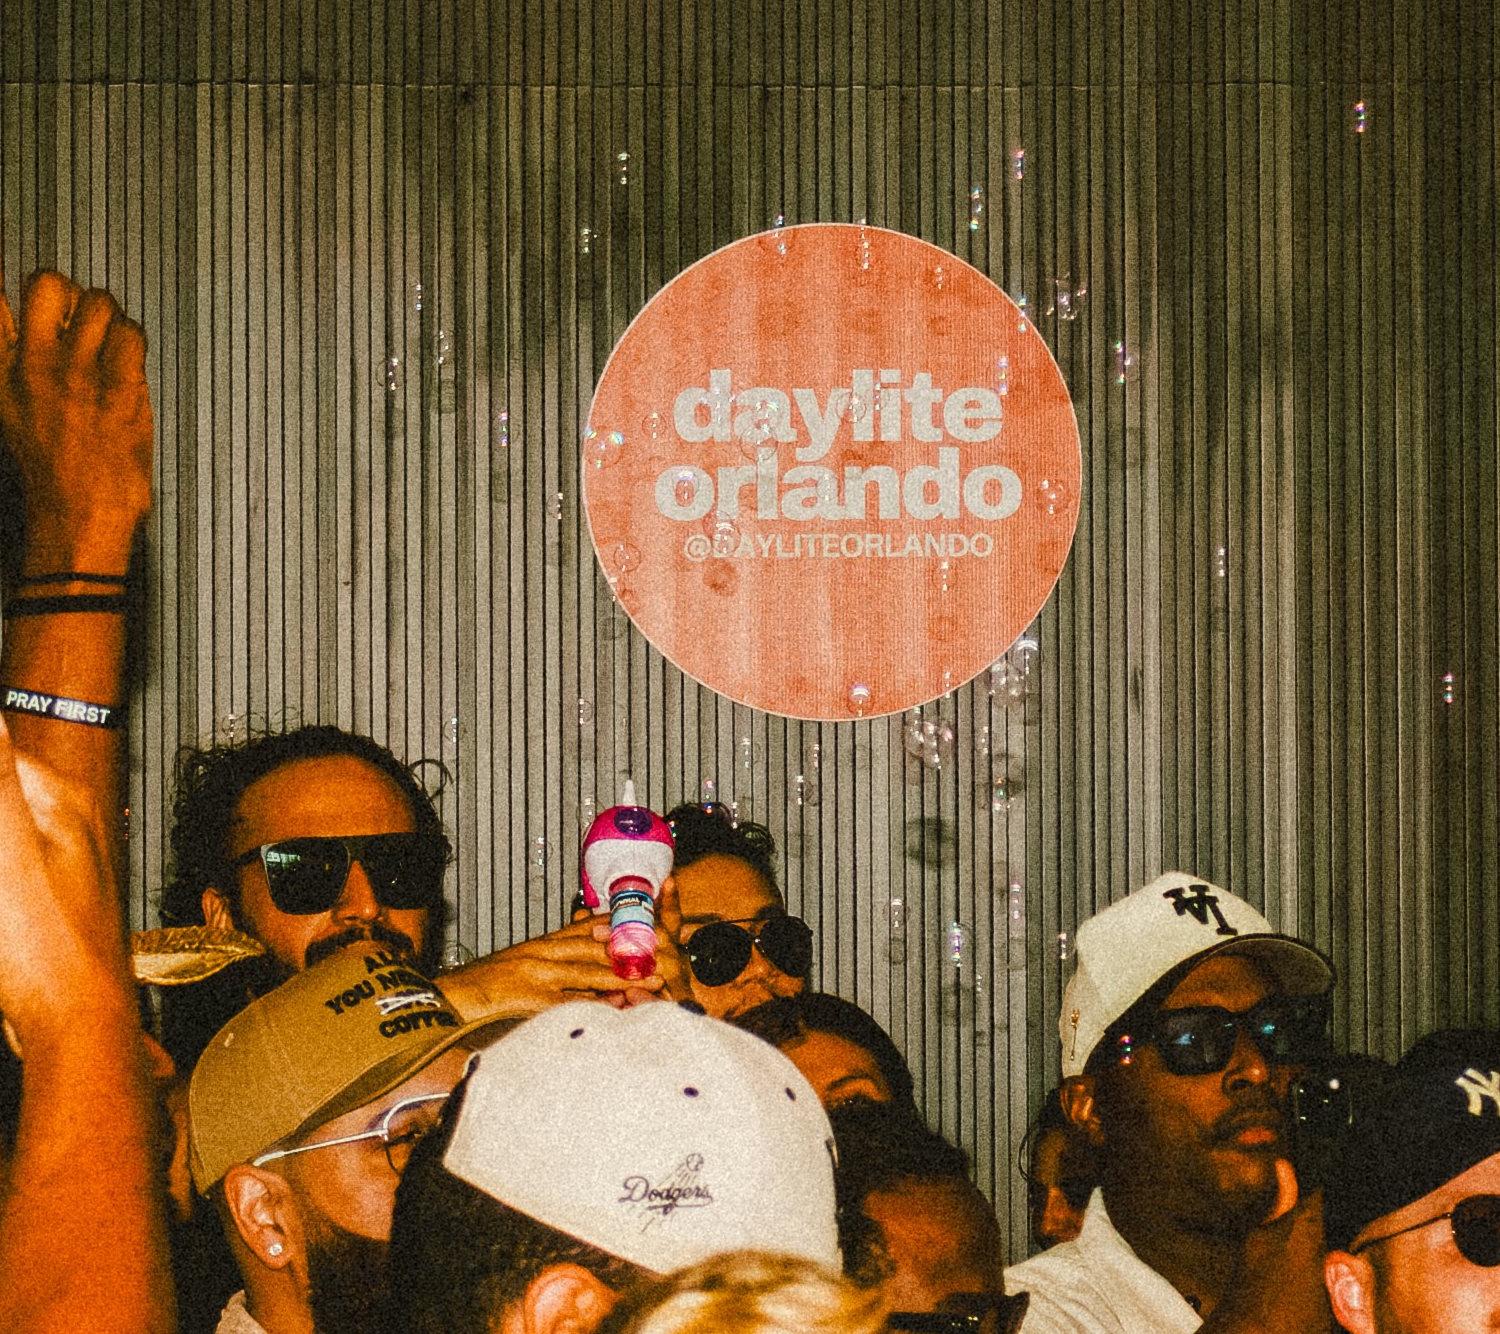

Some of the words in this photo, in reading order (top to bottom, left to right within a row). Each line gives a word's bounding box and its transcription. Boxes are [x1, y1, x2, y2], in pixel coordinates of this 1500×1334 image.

[672, 368, 1004, 462] daylite
[654, 446, 1023, 521] orlando
[683, 531, 995, 562] @DAYLITEORLANDO
[6, 690, 53, 713] PRAY
[53, 698, 111, 724] FIRST
[325, 979, 376, 1016] YOU
[617, 1174, 714, 1216] Dodgers
